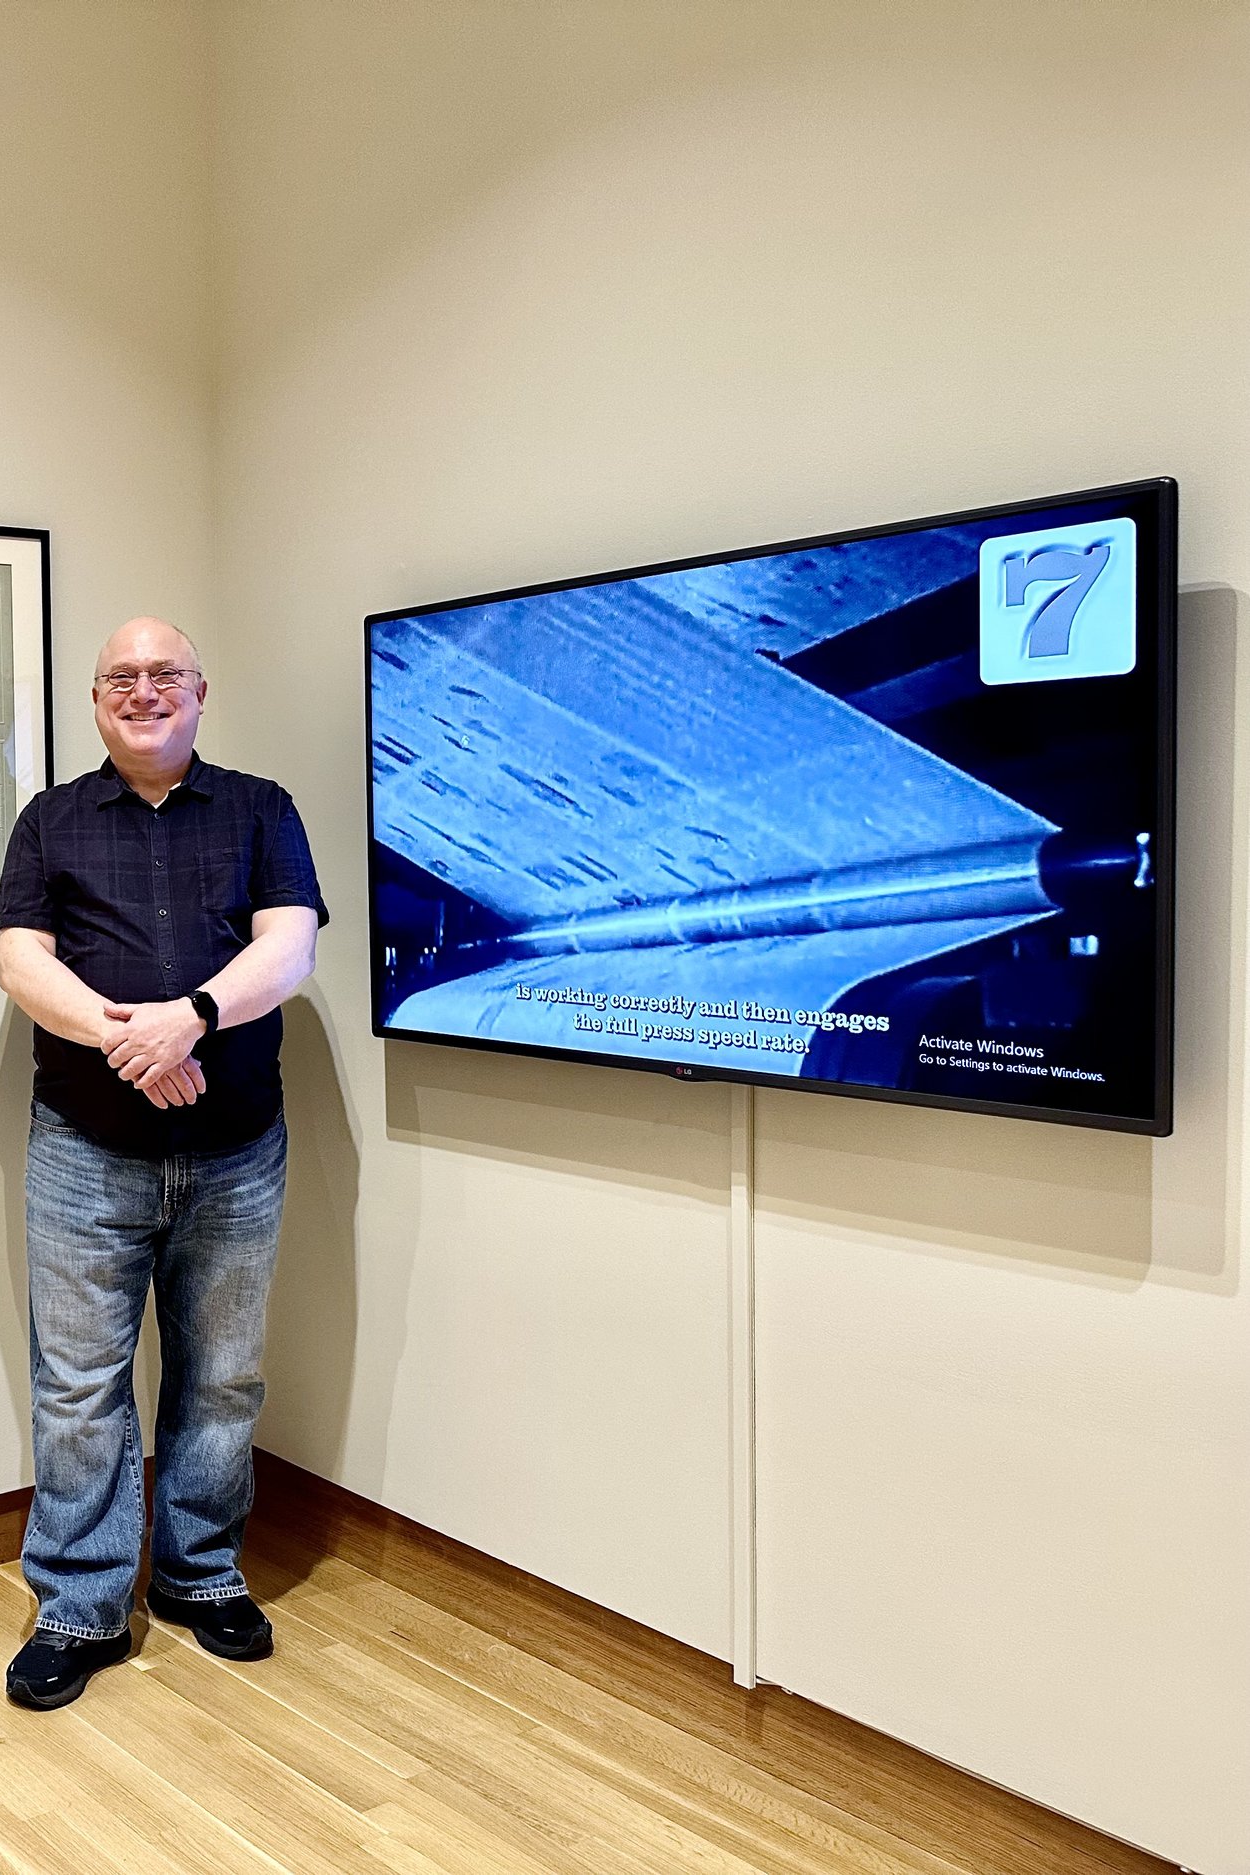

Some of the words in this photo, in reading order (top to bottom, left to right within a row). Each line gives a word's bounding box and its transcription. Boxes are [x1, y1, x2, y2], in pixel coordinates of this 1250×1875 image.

[1006, 546, 1110, 658] 7
[515, 983, 532, 1000] is
[533, 985, 608, 1010] working
[609, 993, 697, 1019] correctly
[699, 1000, 737, 1020] and
[741, 1002, 790, 1025] then
[794, 1008, 890, 1032] engages
[572, 1013, 602, 1032] the
[605, 1016, 637, 1036] full
[640, 1021, 693, 1042] press
[697, 1026, 756, 1049] speed
[760, 1033, 810, 1055] rate.
[918, 1034, 973, 1051] Activate
[976, 1039, 1044, 1058] Windows
[918, 1053, 934, 1064] Go
[936, 1056, 947, 1066] to
[949, 1056, 990, 1072] Settings
[992, 1061, 1004, 1072] to
[1006, 1063, 1048, 1075] activate
[1050, 1065, 1106, 1082] Windows.
